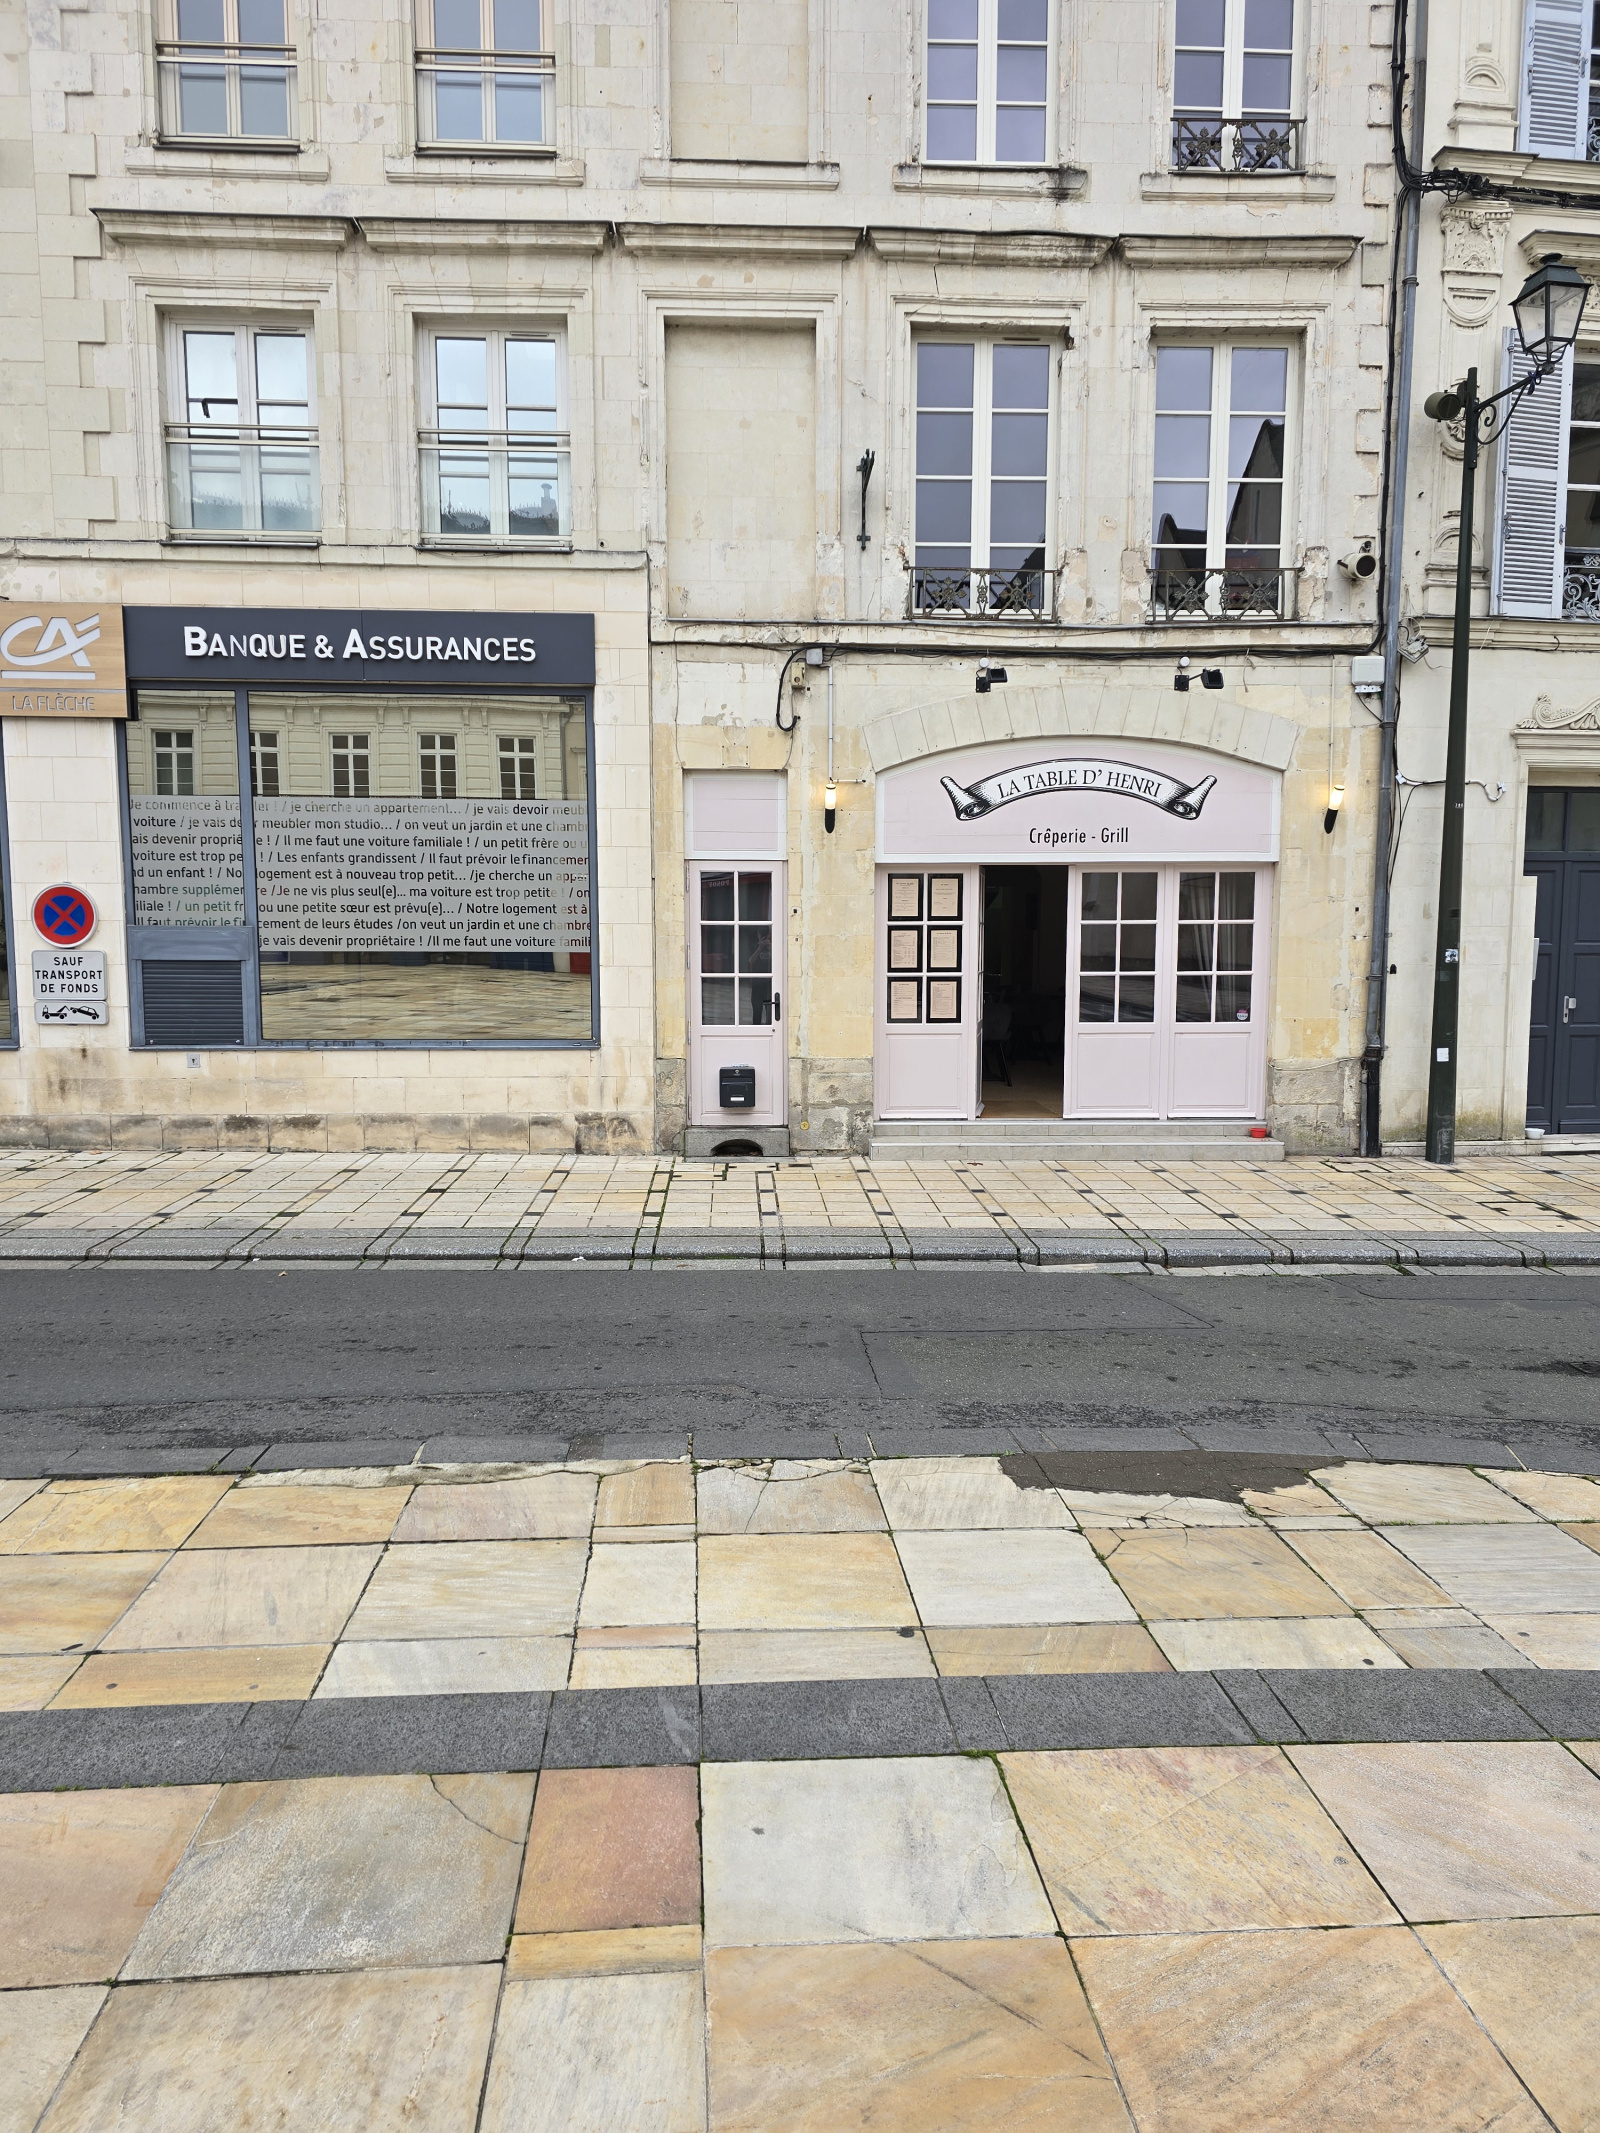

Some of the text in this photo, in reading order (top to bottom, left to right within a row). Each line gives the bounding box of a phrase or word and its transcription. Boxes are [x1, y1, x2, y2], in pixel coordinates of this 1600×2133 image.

[314, 635, 334, 659] &
[12, 692, 95, 711] LA FLÈCHE
[996, 779, 1021, 799] LA
[1023, 769, 1077, 790] TABLE
[1106, 771, 1162, 798] HENRI
[129, 799, 142, 810] Je
[145, 801, 210, 811] commence
[214, 800, 221, 811] à
[290, 801, 301, 814] je
[304, 801, 352, 812] cherche
[356, 804, 370, 813] un
[373, 802, 461, 816] appartement...
[472, 803, 484, 816] je
[487, 803, 510, 814] vais
[512, 803, 549, 814] devoir
[552, 804, 586, 815] meub
[133, 815, 176, 827] voiture
[188, 816, 199, 830] je
[203, 816, 226, 828] vais
[262, 817, 311, 829] meubler
[314, 820, 340, 829] mon
[344, 818, 392, 829] studio...
[404, 821, 419, 830] on
[422, 818, 448, 830] veut
[452, 821, 466, 830] un
[469, 819, 503, 833] jardin
[506, 819, 518, 831] et
[521, 822, 543, 831] une
[546, 820, 588, 831] chambr
[132, 832, 149, 844] ais
[152, 833, 196, 845] devenir
[284, 834, 291, 845] Il
[294, 837, 313, 846] me
[316, 834, 340, 846] faut
[343, 837, 365, 846] une
[368, 835, 410, 847] voiture
[413, 835, 463, 847] familiale
[483, 838, 498, 847] un
[501, 836, 528, 850] petit
[531, 836, 559, 848] frère
[562, 839, 577, 848] ou
[1029, 827, 1086, 847] Crêperie
[1101, 827, 1128, 843] Grill
[132, 849, 176, 861] voiture
[179, 850, 196, 861] est
[201, 850, 225, 864] trop
[277, 851, 298, 862] Les
[300, 851, 345, 863] enfants
[348, 851, 417, 866] grandissent
[429, 852, 436, 864] Il
[439, 852, 463, 864] faut
[466, 852, 507, 867] prévoir
[510, 853, 520, 864] le
[148, 869, 163, 878] un
[166, 866, 205, 878] enfant
[255, 867, 312, 882] logement
[314, 868, 332, 879] est
[336, 868, 343, 879] à
[346, 870, 396, 880] nouveau
[399, 868, 424, 882] trop
[427, 869, 466, 883] petit...
[470, 869, 485, 881] /je
[488, 869, 535, 881] cherche
[538, 872, 552, 881] un
[556, 872, 589, 884] appar
[270, 884, 290, 896] /Je
[293, 887, 308, 896] ne
[311, 884, 328, 896] vis
[330, 884, 355, 899] plus
[358, 884, 406, 899] seul(e)...
[409, 888, 428, 897] ma
[430, 885, 472, 897] voiture
[475, 886, 493, 897] est
[495, 886, 520, 900] trop
[524, 886, 557, 900] petite
[576, 889, 590, 898] on
[135, 900, 164, 912] iliale
[185, 903, 200, 912] un
[203, 900, 231, 915] petit
[258, 903, 273, 912] ou
[276, 903, 298, 912] une
[302, 901, 336, 915] petite
[340, 904, 370, 913] sœur
[373, 901, 391, 913] est
[394, 901, 454, 916] prévu(e)...
[466, 902, 499, 914] Notre
[502, 902, 557, 917] logement
[560, 903, 578, 914] est
[580, 903, 588, 914] à
[304, 917, 318, 929] de
[321, 917, 350, 929] leurs
[354, 917, 393, 929] études
[397, 918, 417, 930] /on
[420, 918, 446, 929] veut
[450, 921, 464, 929] un
[466, 918, 500, 932] jardin
[503, 918, 515, 930] et
[518, 921, 540, 930] une
[543, 919, 590, 930] chambre
[259, 934, 270, 948] je
[273, 934, 296, 946] vais
[299, 934, 343, 946] devenir
[346, 934, 416, 949] propriétaire
[427, 935, 440, 947] /Il
[443, 937, 460, 946] me
[464, 935, 488, 946] faut
[490, 938, 512, 947] une
[515, 935, 556, 947] voiture
[559, 935, 590, 947] famili
[54, 956, 83, 966] SAUF
[35, 970, 102, 979] TRANSPORT
[41, 984, 98, 993] DE FONDS
